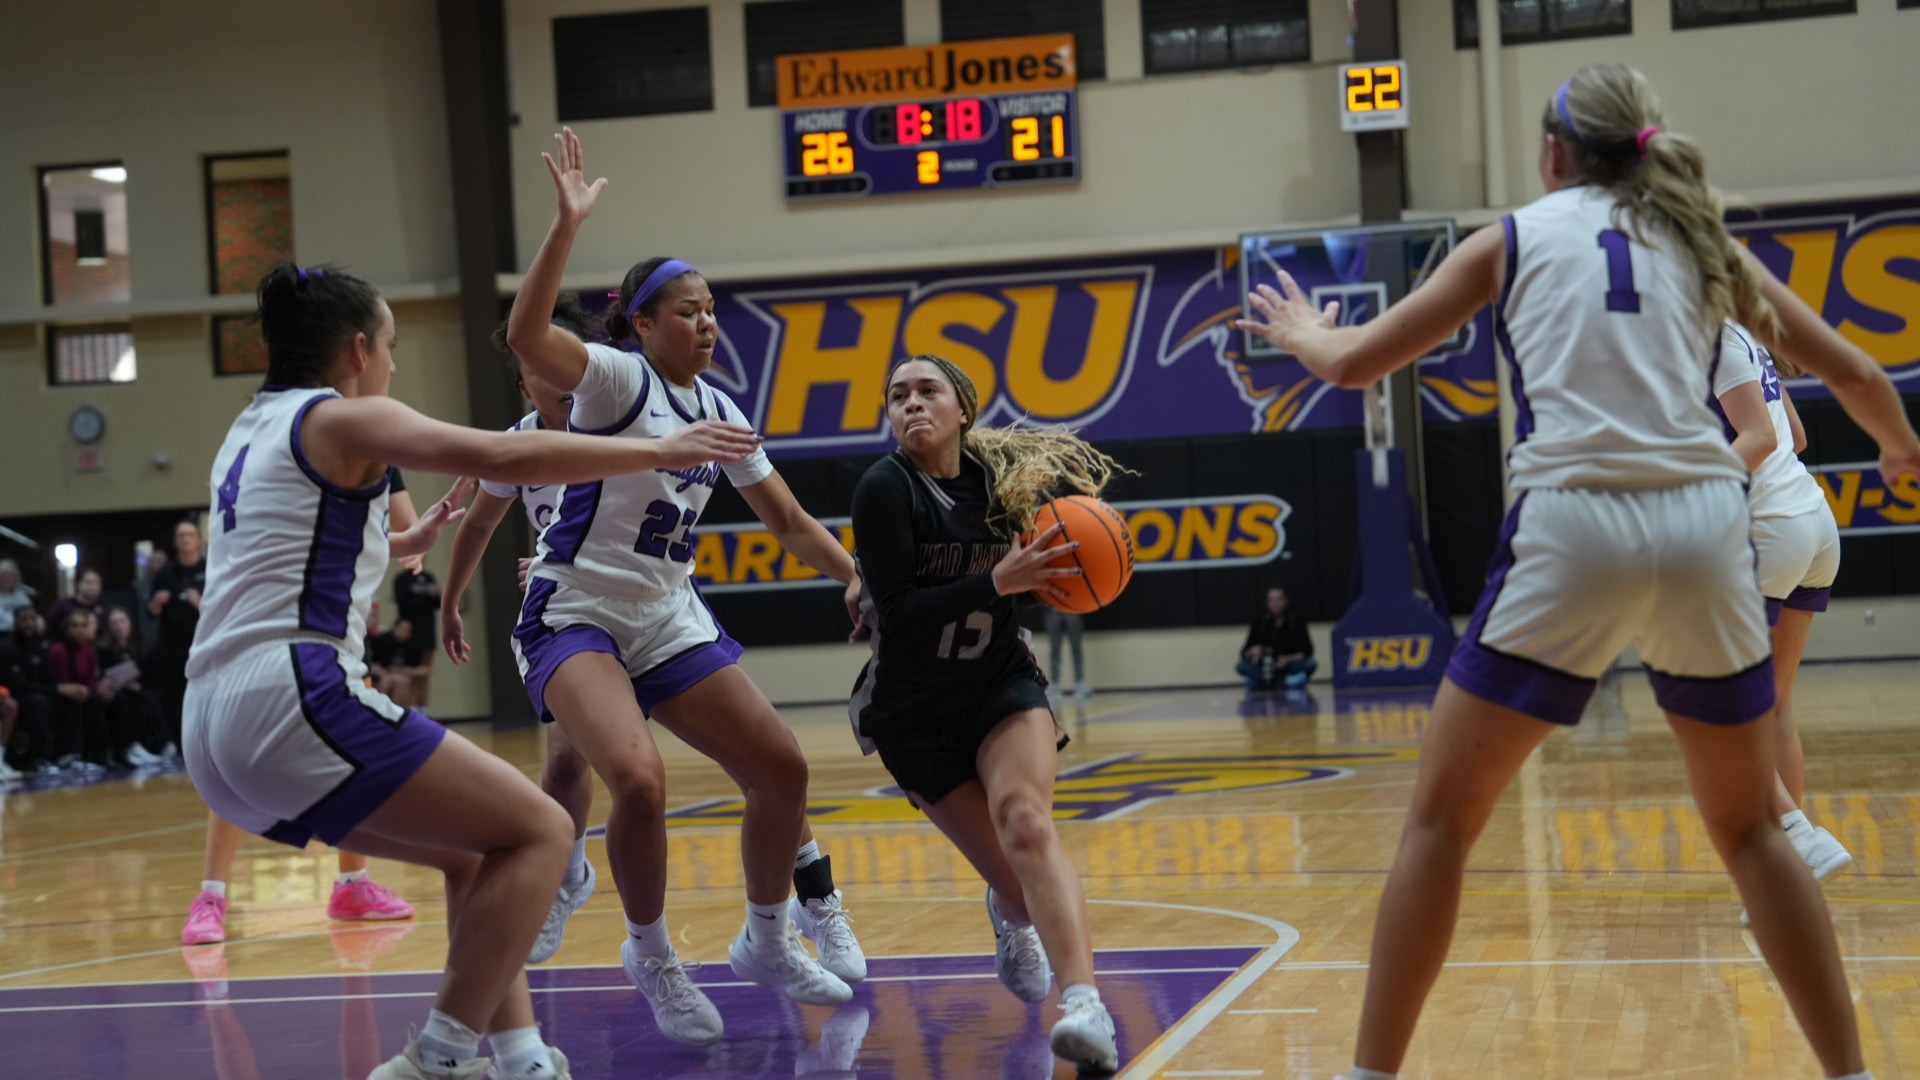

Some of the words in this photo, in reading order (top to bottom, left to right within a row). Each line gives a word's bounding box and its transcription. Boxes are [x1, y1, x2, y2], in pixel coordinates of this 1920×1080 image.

[789, 50, 936, 99] Edward
[941, 48, 1066, 92] Jones
[1347, 65, 1401, 112] 22
[794, 110, 849, 132] HOME
[896, 98, 982, 145] 8:18
[1000, 94, 1067, 118] VISITOR
[802, 131, 854, 176] 26
[1011, 115, 1064, 161] 21
[917, 150, 940, 184] 2
[1597, 229, 1640, 314] 1
[763, 279, 1139, 437] HSU
[217, 443, 250, 534] 4
[917, 542, 964, 577] WAR
[1350, 635, 1432, 672] HSU
